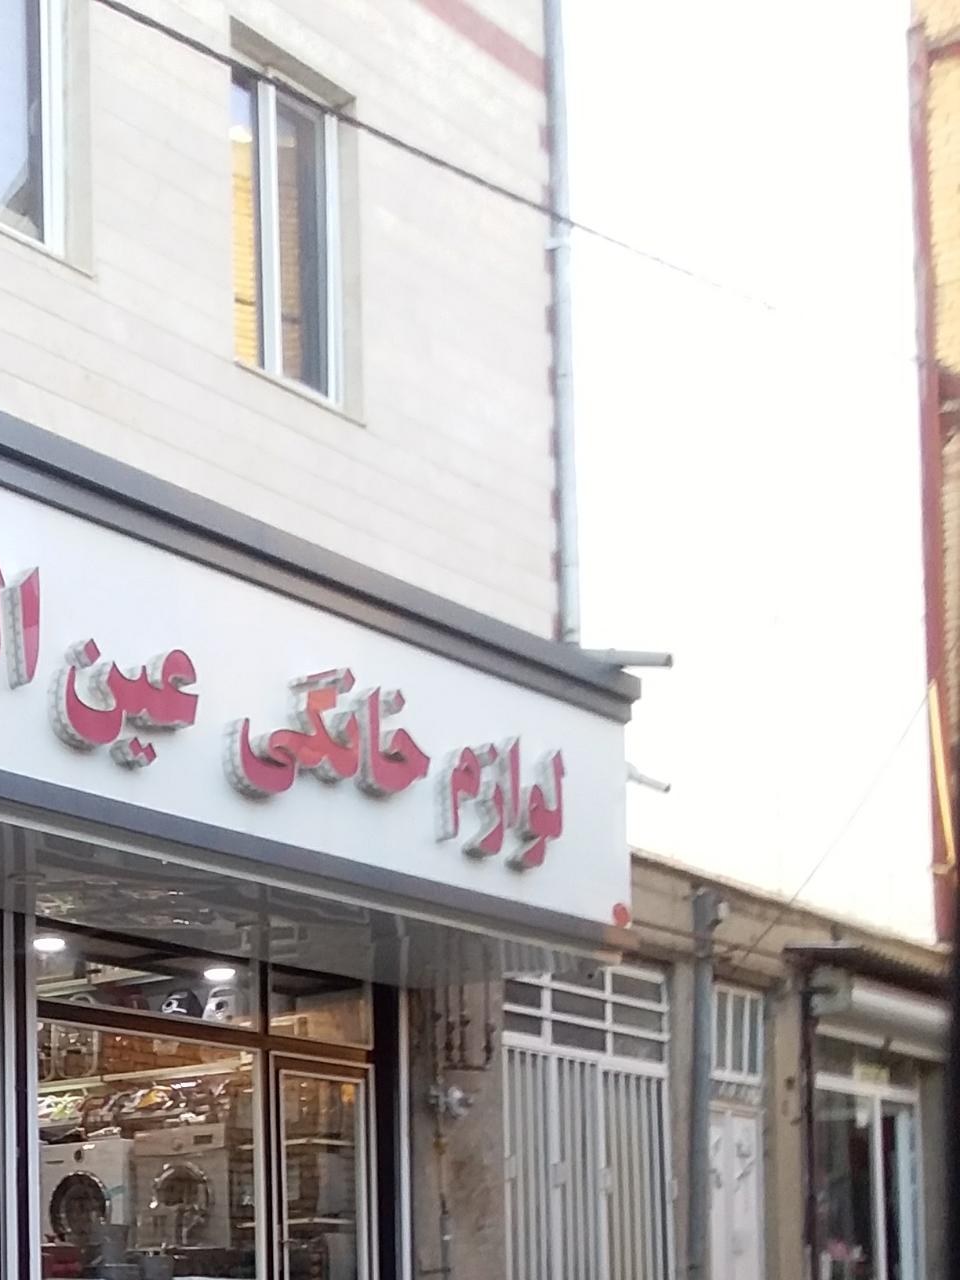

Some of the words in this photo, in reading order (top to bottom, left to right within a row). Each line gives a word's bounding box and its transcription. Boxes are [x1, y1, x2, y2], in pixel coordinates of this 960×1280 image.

[48, 638, 200, 770] عین
[224, 668, 431, 800] خانگی
[437, 735, 566, 873] لوازم
